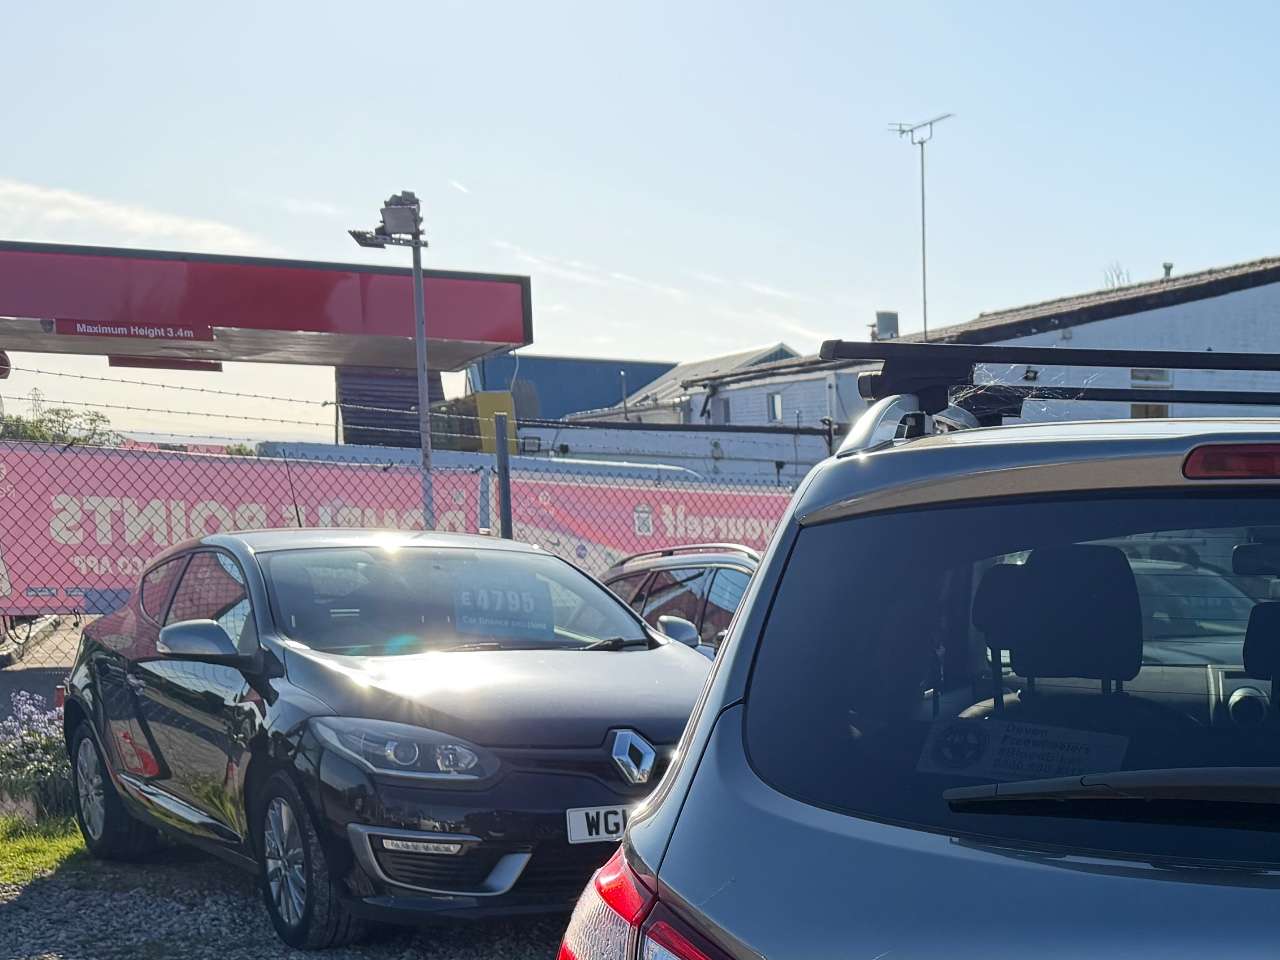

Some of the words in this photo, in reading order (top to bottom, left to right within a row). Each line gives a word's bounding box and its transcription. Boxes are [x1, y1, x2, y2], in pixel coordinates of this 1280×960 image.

[76, 323, 128, 335] Maximum
[130, 325, 165, 338] Height
[167, 326, 194, 338] 3.4m
